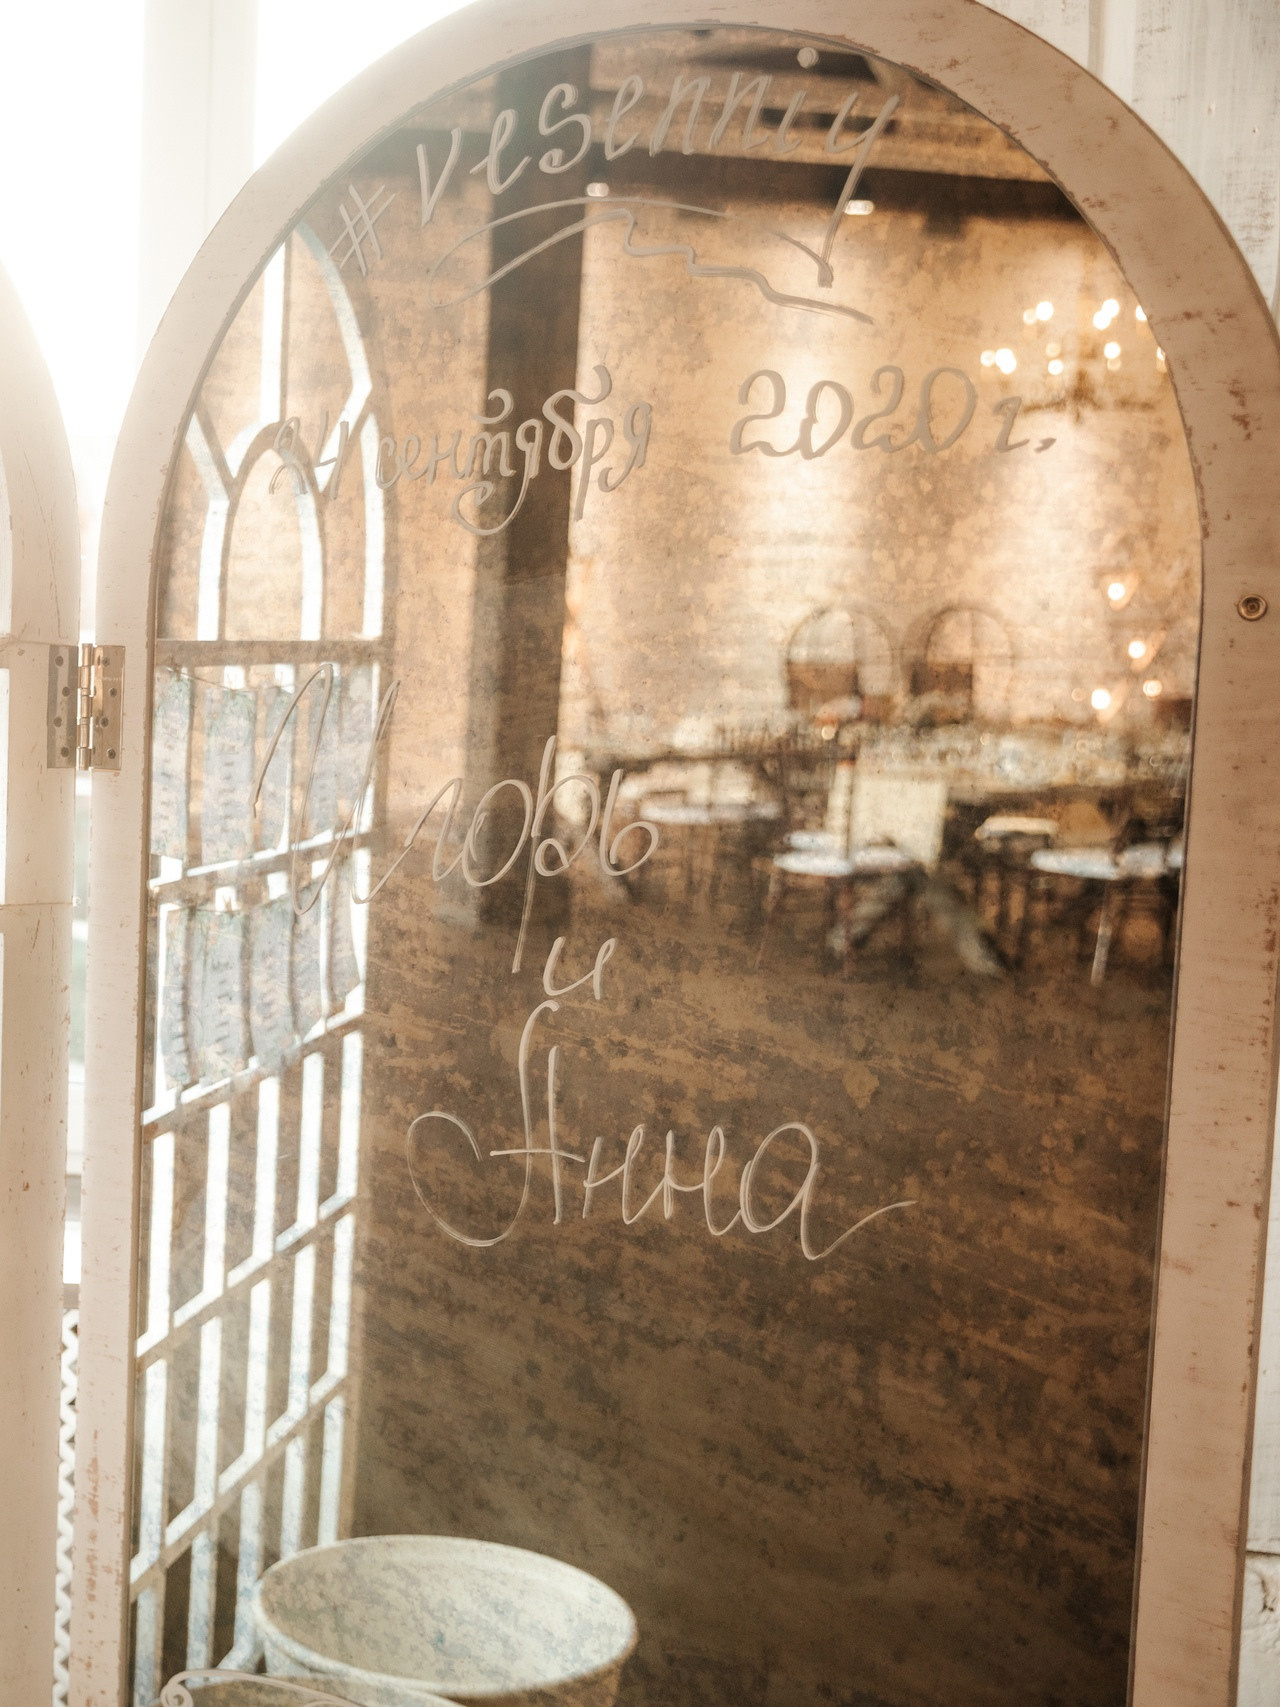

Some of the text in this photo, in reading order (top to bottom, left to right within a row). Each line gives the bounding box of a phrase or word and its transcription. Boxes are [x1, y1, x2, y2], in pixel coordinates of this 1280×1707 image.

[374, 364, 651, 536] сентября
[729, 365, 977, 460] 2020
[542, 936, 618, 999] и
[406, 1000, 918, 1262] Анна
